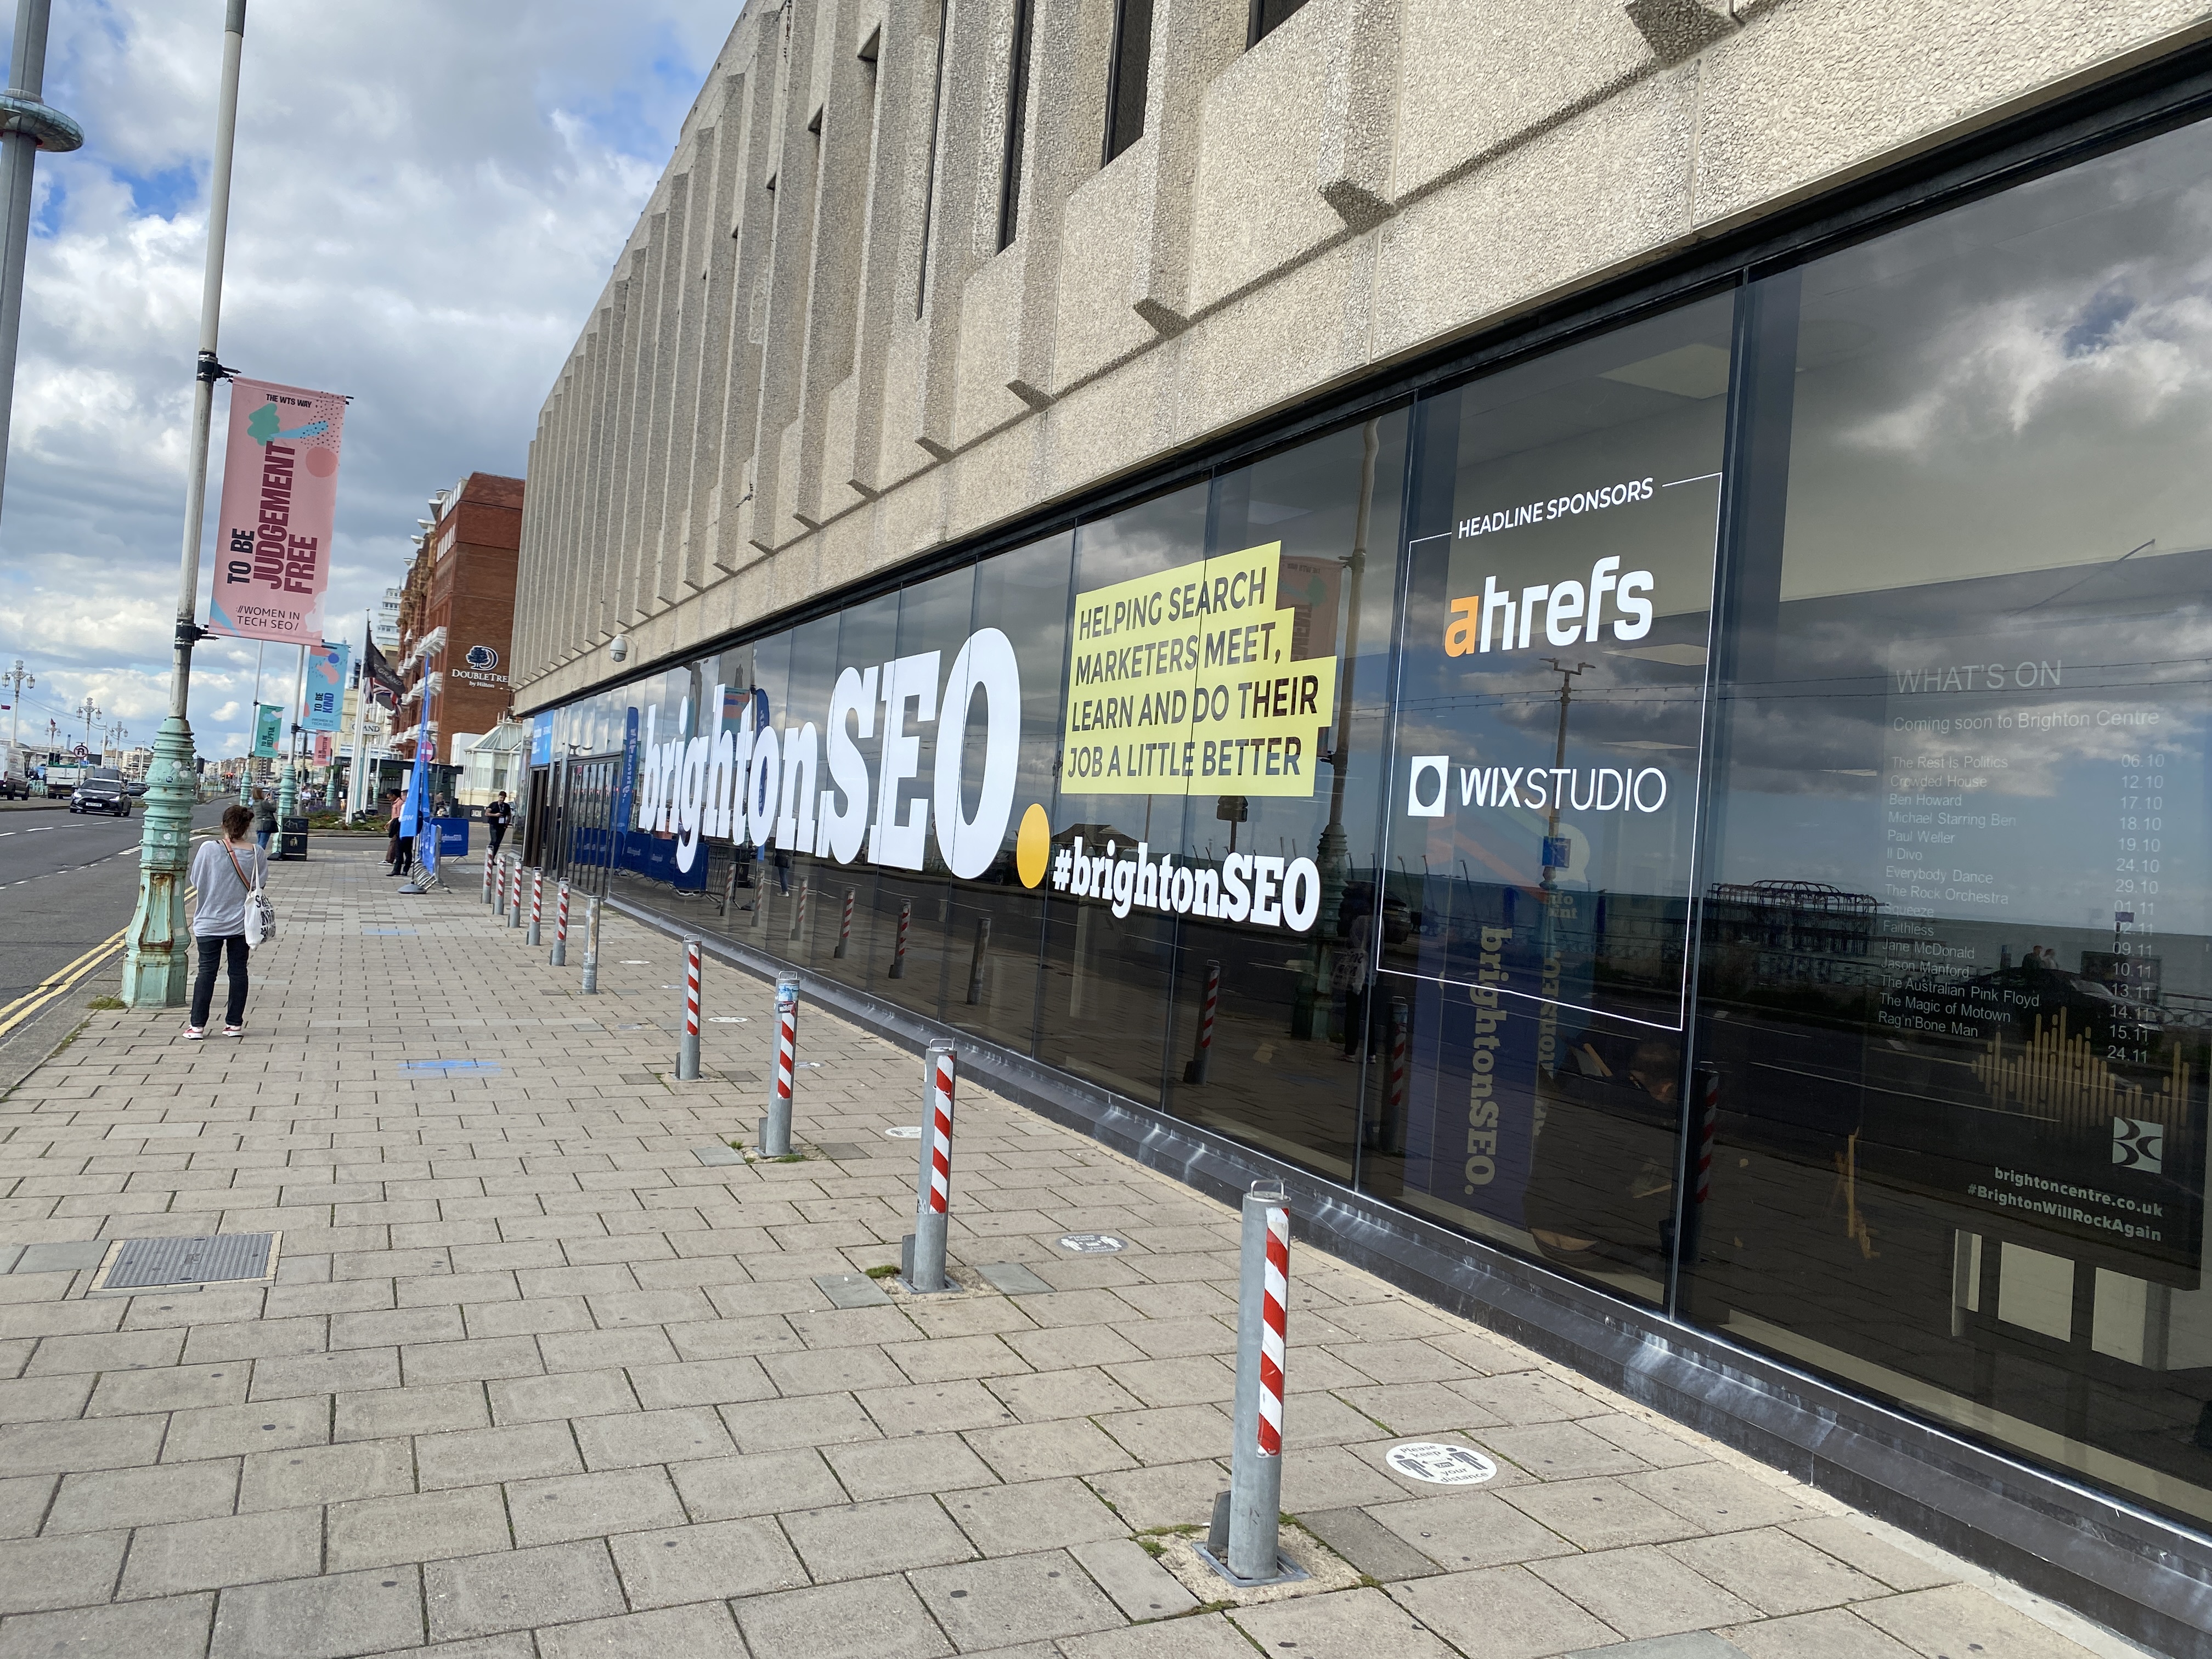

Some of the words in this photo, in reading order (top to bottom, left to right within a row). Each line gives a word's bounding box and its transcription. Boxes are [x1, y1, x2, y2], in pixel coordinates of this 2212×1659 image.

[266, 393, 278, 402] THE
[280, 396, 296, 405] WTS
[297, 399, 312, 408] WAY
[252, 440, 296, 590] JUDGEMENT
[1458, 501, 1543, 539] HEADLINE
[1547, 477, 1654, 521] SPONSORS
[230, 528, 255, 555] BE
[227, 561, 252, 584] TO
[283, 534, 318, 595] FREE
[1080, 591, 1162, 640] HELPING
[1168, 567, 1267, 622] SEARCH
[1444, 555, 1654, 657] ahrefs
[237, 615, 267, 628] TECH
[289, 611, 300, 620] IN
[1076, 635, 1199, 686] MARKETERS
[1204, 622, 1282, 668] MEET,
[452, 669, 509, 682] DOUBLETRE
[1896, 663, 2005, 693] WHAT'S
[2015, 659, 2062, 687] ON
[315, 692, 324, 701] BE
[322, 692, 334, 713] KIND
[1072, 695, 1133, 732] LEARN
[1138, 690, 1187, 727] AND
[1192, 684, 1229, 724] DO
[1238, 675, 1318, 719] THEIR
[314, 703, 323, 712] TO
[1894, 716, 1950, 733] Coming
[1955, 717, 1992, 730] soon
[1997, 714, 2012, 729] to
[2018, 712, 2090, 731] Brighton
[2096, 710, 2160, 726] Centre
[267, 726, 275, 748] HELPFUL
[1068, 746, 1103, 778] JOB
[1107, 745, 1121, 777] A
[1126, 741, 1195, 777] LITTLE
[1202, 736, 1301, 776] BETTER
[1892, 757, 1913, 768] The
[1917, 756, 1944, 768] Rest
[1949, 756, 1959, 768] Is
[1964, 755, 2008, 768] Politics
[2121, 754, 2164, 768] 06.10
[1891, 775, 1942, 787] Crowded
[1947, 775, 1987, 787] House
[2121, 775, 2163, 788] 12.10
[1889, 793, 1911, 805] Ben
[1916, 794, 1962, 806] Howard
[2121, 797, 2162, 810] 17.10
[1888, 811, 1932, 823] Michael
[1938, 812, 1986, 829] Starring
[1991, 813, 2016, 826] Ben
[2120, 817, 2162, 831] 18.10
[1888, 830, 1912, 842] Paul
[1917, 830, 1955, 843] Weller
[2119, 838, 2160, 852] 19.10
[1897, 848, 1922, 860] Divo
[2116, 858, 2159, 873] 24.10
[1052, 836, 1321, 932] #brightonSEO
[1886, 866, 1946, 884] Everybody
[1953, 869, 1993, 884] Dance
[1885, 884, 1907, 897] The
[1911, 885, 1940, 899] Rock
[1945, 888, 2008, 904] Orchestra
[2115, 879, 2158, 894] 29.10
[1883, 902, 1934, 917] Squeeze
[1883, 920, 1934, 936] Faithless
[2114, 921, 2153, 936] 02.11
[1882, 938, 1910, 952] Jane
[1914, 941, 1974, 959] McDonald
[2113, 942, 2152, 957] 09.11
[1881, 957, 1915, 972] Jason
[1920, 961, 1970, 978] Manford
[2113, 962, 2151, 978] 10.11
[1881, 974, 1903, 988] The
[1905, 977, 1965, 997] Australian
[1971, 986, 1998, 1001] Pink
[2004, 990, 2039, 1008] Floyd
[2112, 983, 2149, 999] 13.11
[1880, 992, 1901, 1006] The
[1906, 996, 1940, 1014] Magic
[1945, 1002, 1957, 1015] of
[1961, 1003, 2011, 1023] Motown
[2111, 1005, 2148, 1022] 14.11
[1878, 1011, 1946, 1032] Rag'n'Bone
[1951, 1022, 1978, 1037] Man
[2109, 1024, 2148, 1042] 15.11
[1464, 926, 1513, 1195] brightonSEO.
[2107, 1045, 2147, 1064] 24.11
[1995, 1166, 2163, 1217] brightoncentre.co.uk
[1967, 1183, 2162, 1242] #BrightonWillRockAgain
[1400, 1445, 1437, 1453] Please
[1440, 1473, 1489, 1483] distance
